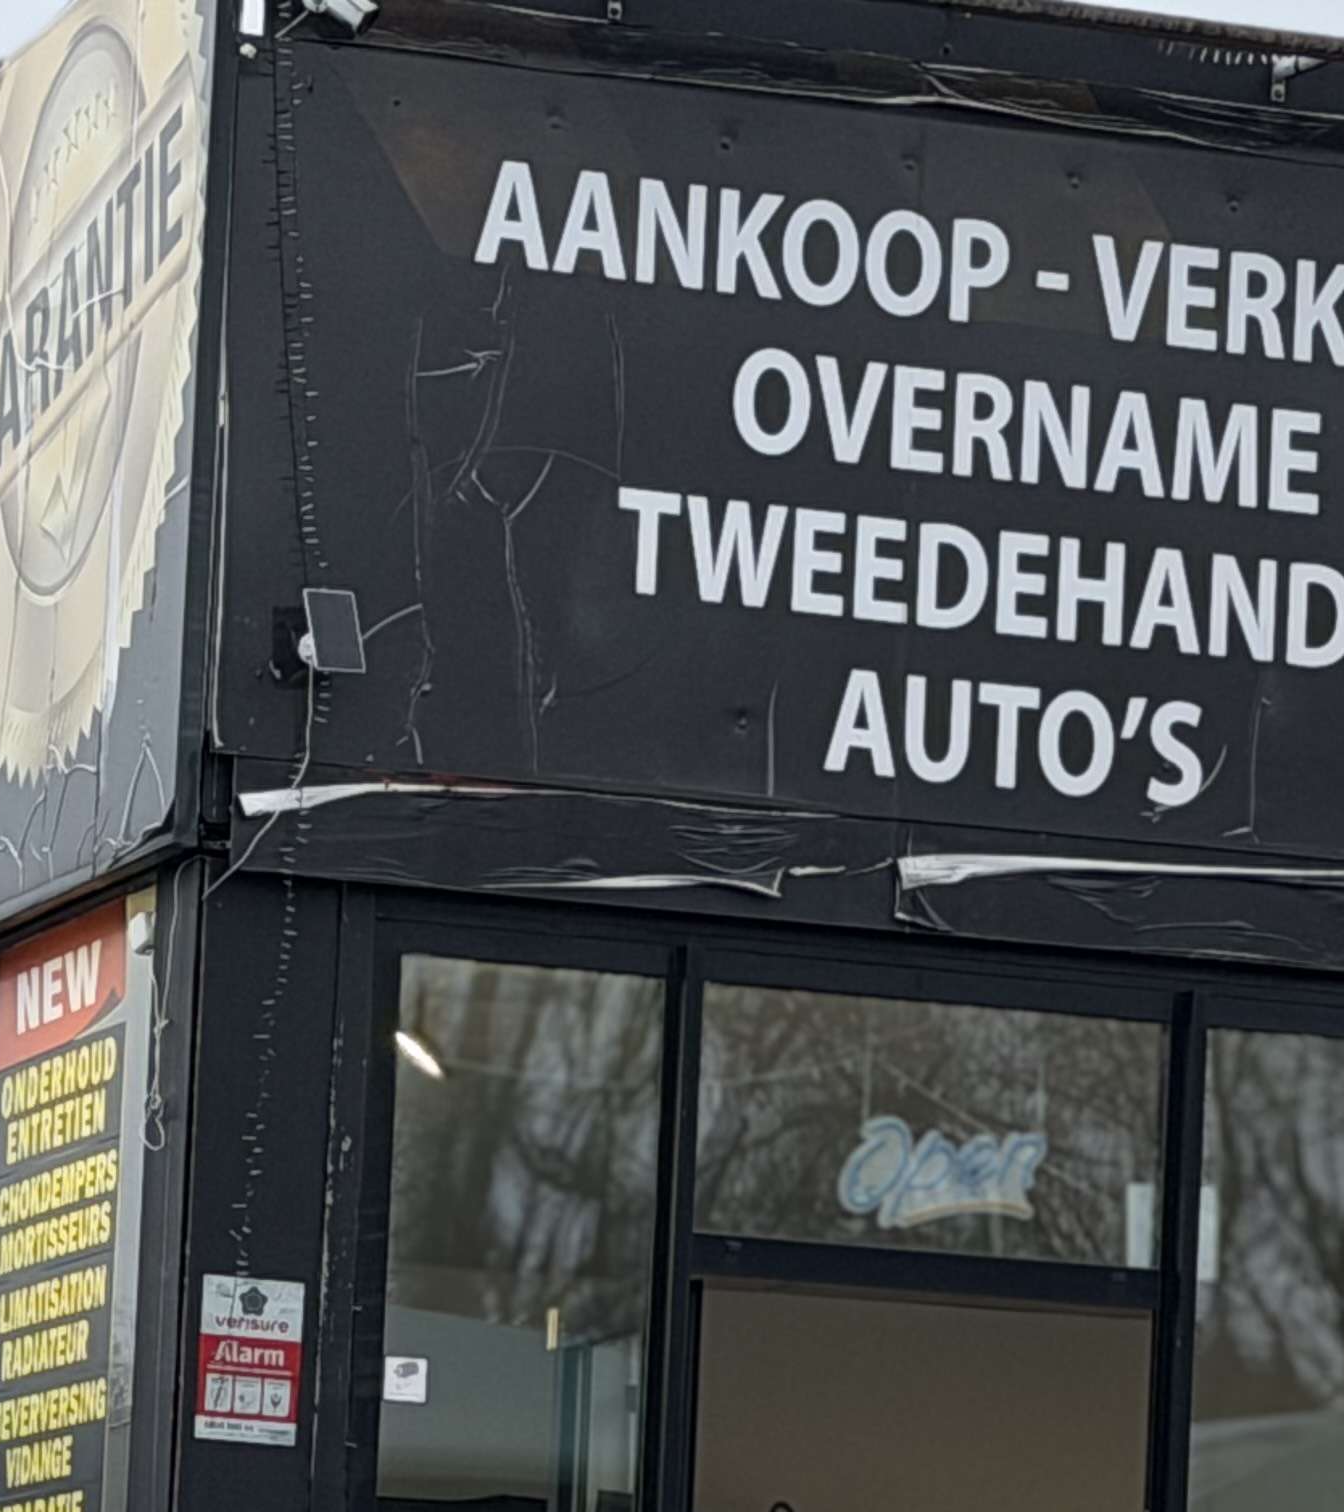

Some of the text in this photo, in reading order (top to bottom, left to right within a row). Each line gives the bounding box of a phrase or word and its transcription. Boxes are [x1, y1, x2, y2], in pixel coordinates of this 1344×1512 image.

[473, 160, 1010, 323] AANKOOP
[732, 347, 1322, 515] OVERNAME
[823, 669, 1204, 807] AUTO'S
[16, 939, 102, 1036] NEW
[1, 1036, 117, 1119] ONDERHOUD
[6, 1088, 106, 1165] ENTRETIEN
[839, 1116, 1047, 1228] Open
[1, 1319, 90, 1382] RADIATEUR
[213, 1339, 285, 1368] Alarm
[215, 1314, 290, 1334] verisure
[5, 1434, 73, 1488] VIDANGE
